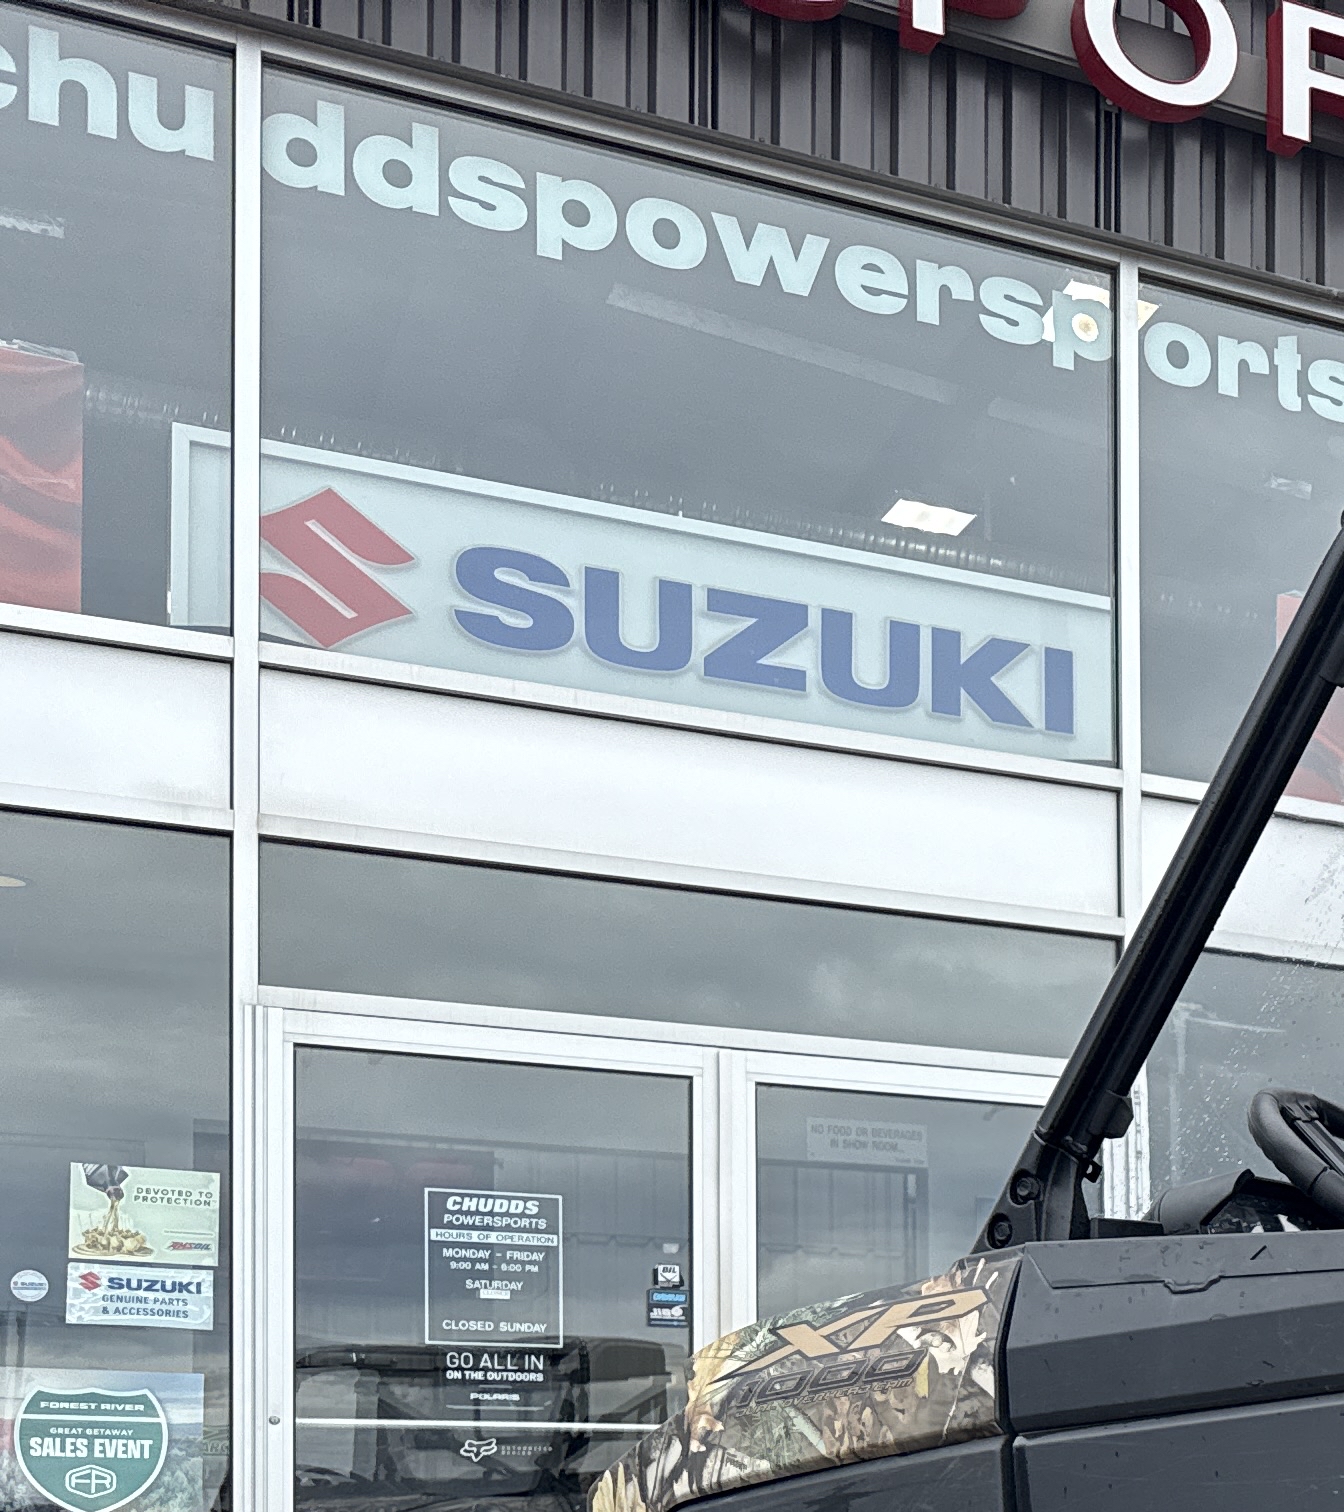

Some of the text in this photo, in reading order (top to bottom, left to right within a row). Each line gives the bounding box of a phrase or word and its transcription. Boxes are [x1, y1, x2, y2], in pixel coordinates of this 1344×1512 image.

[453, 546, 1075, 736] SUZUKI
[827, 1125, 852, 1137] FOOD
[136, 1187, 213, 1199] DEVOTED TO
[446, 1196, 540, 1215] CHUDDS
[443, 1214, 548, 1229] POWERSPORTS
[435, 1231, 555, 1244] HOURS OF OPERATION
[442, 1248, 491, 1260] MONDAY
[506, 1251, 546, 1262] FRIDAY
[450, 1261, 472, 1270] 9:00
[475, 1262, 489, 1271] AM
[525, 1264, 539, 1273] PM
[107, 1276, 203, 1295] SUZUKI
[465, 1279, 524, 1291] SATURDAY
[102, 1294, 189, 1307] GENUINE PARTS
[102, 1306, 189, 1319] & ACCESSORIES
[442, 1320, 547, 1333] CLOSED SUNDAY
[708, 1287, 992, 1385] XP
[446, 1352, 544, 1370] GO ALL IN
[446, 1370, 544, 1382] ON THE OUTDOORS
[735, 1349, 929, 1408] 1000
[469, 1392, 520, 1401] POLARIS
[40, 1401, 145, 1411] FOREST RIVER
[50, 1427, 133, 1436] GREAT GETAWAY
[29, 1437, 153, 1459] SALES EVENT
